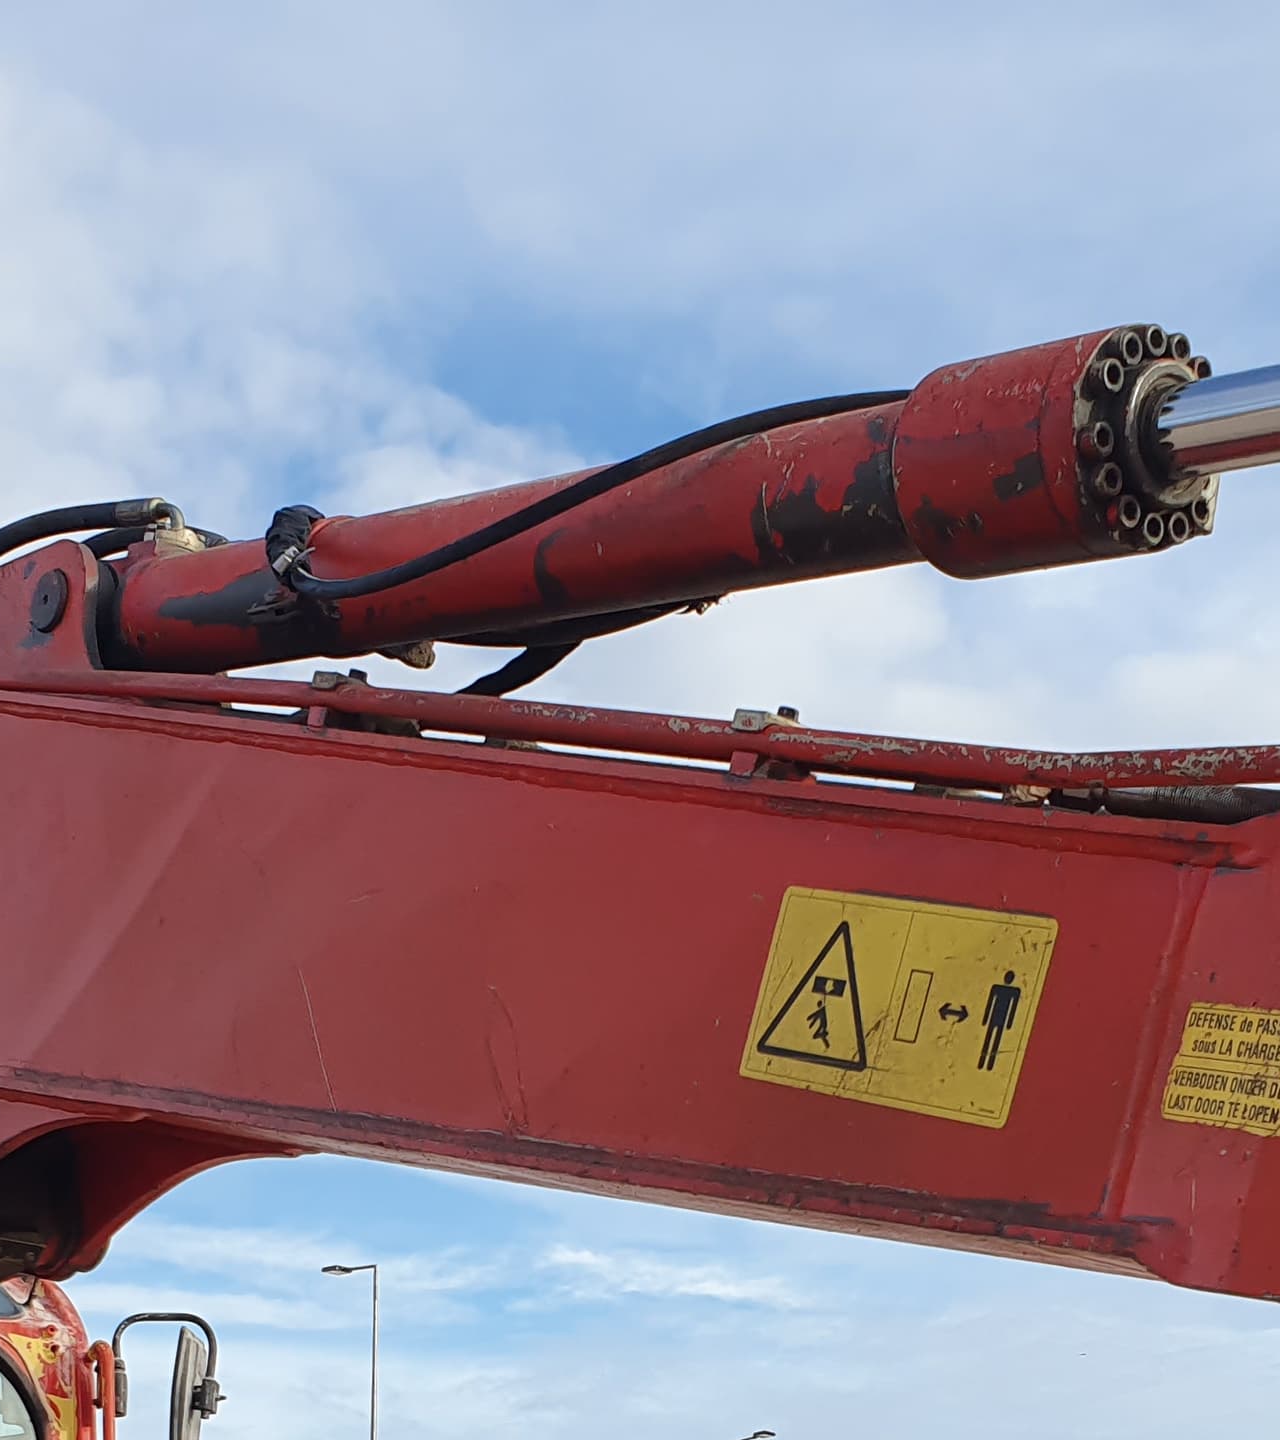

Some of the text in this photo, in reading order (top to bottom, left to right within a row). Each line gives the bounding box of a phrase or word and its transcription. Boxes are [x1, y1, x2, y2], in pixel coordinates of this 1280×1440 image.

[1188, 1011, 1236, 1032] DEFENSE
[1239, 1017, 1253, 1033] de
[1192, 1039, 1217, 1055] sous
[1218, 1039, 1232, 1056] LA
[1173, 1069, 1228, 1093] VERBODEN
[1230, 1077, 1267, 1097] ONDER
[1168, 1093, 1280, 1124] LAST DOOR TE LOPEN
